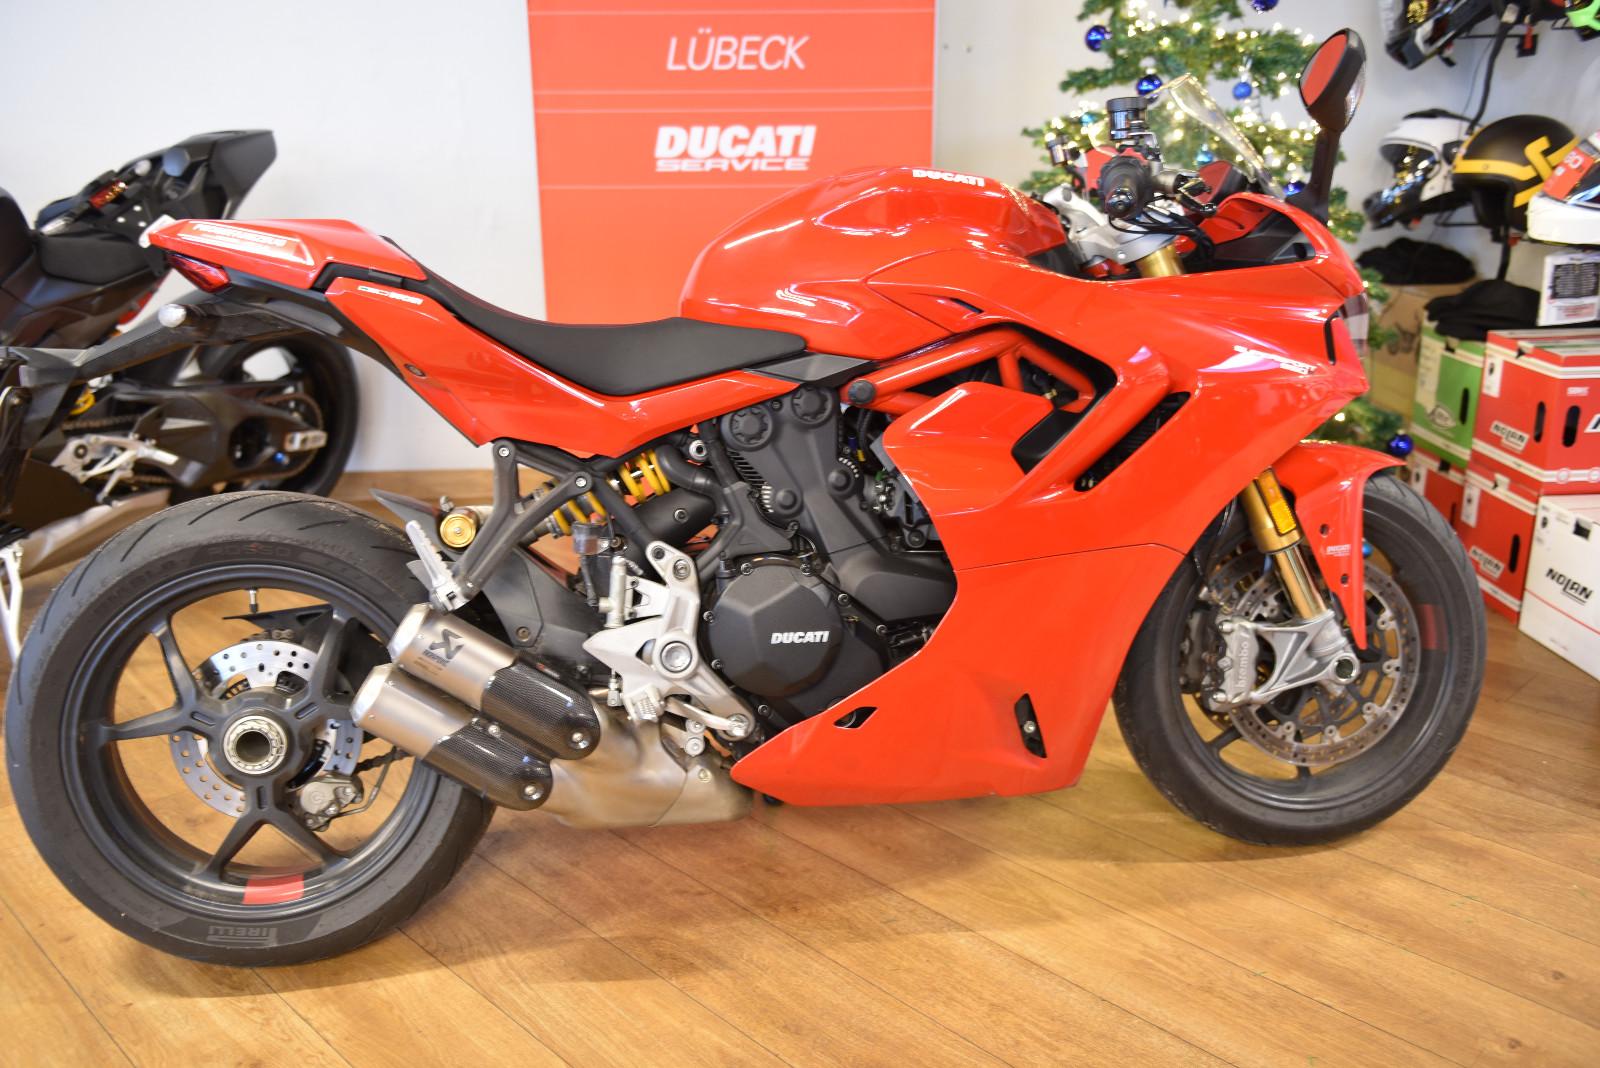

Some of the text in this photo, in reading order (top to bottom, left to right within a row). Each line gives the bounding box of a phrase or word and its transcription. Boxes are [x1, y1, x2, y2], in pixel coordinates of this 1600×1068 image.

[666, 27, 811, 71] LÜBECK
[654, 124, 817, 158] DUCATI
[655, 158, 811, 172] SERVICE
[912, 168, 986, 187] DUCATI
[1546, 567, 1594, 603] NOLAN
[770, 631, 830, 645] DUCATI
[1234, 640, 1249, 689] brembo
[206, 926, 279, 947] PIRELLI
